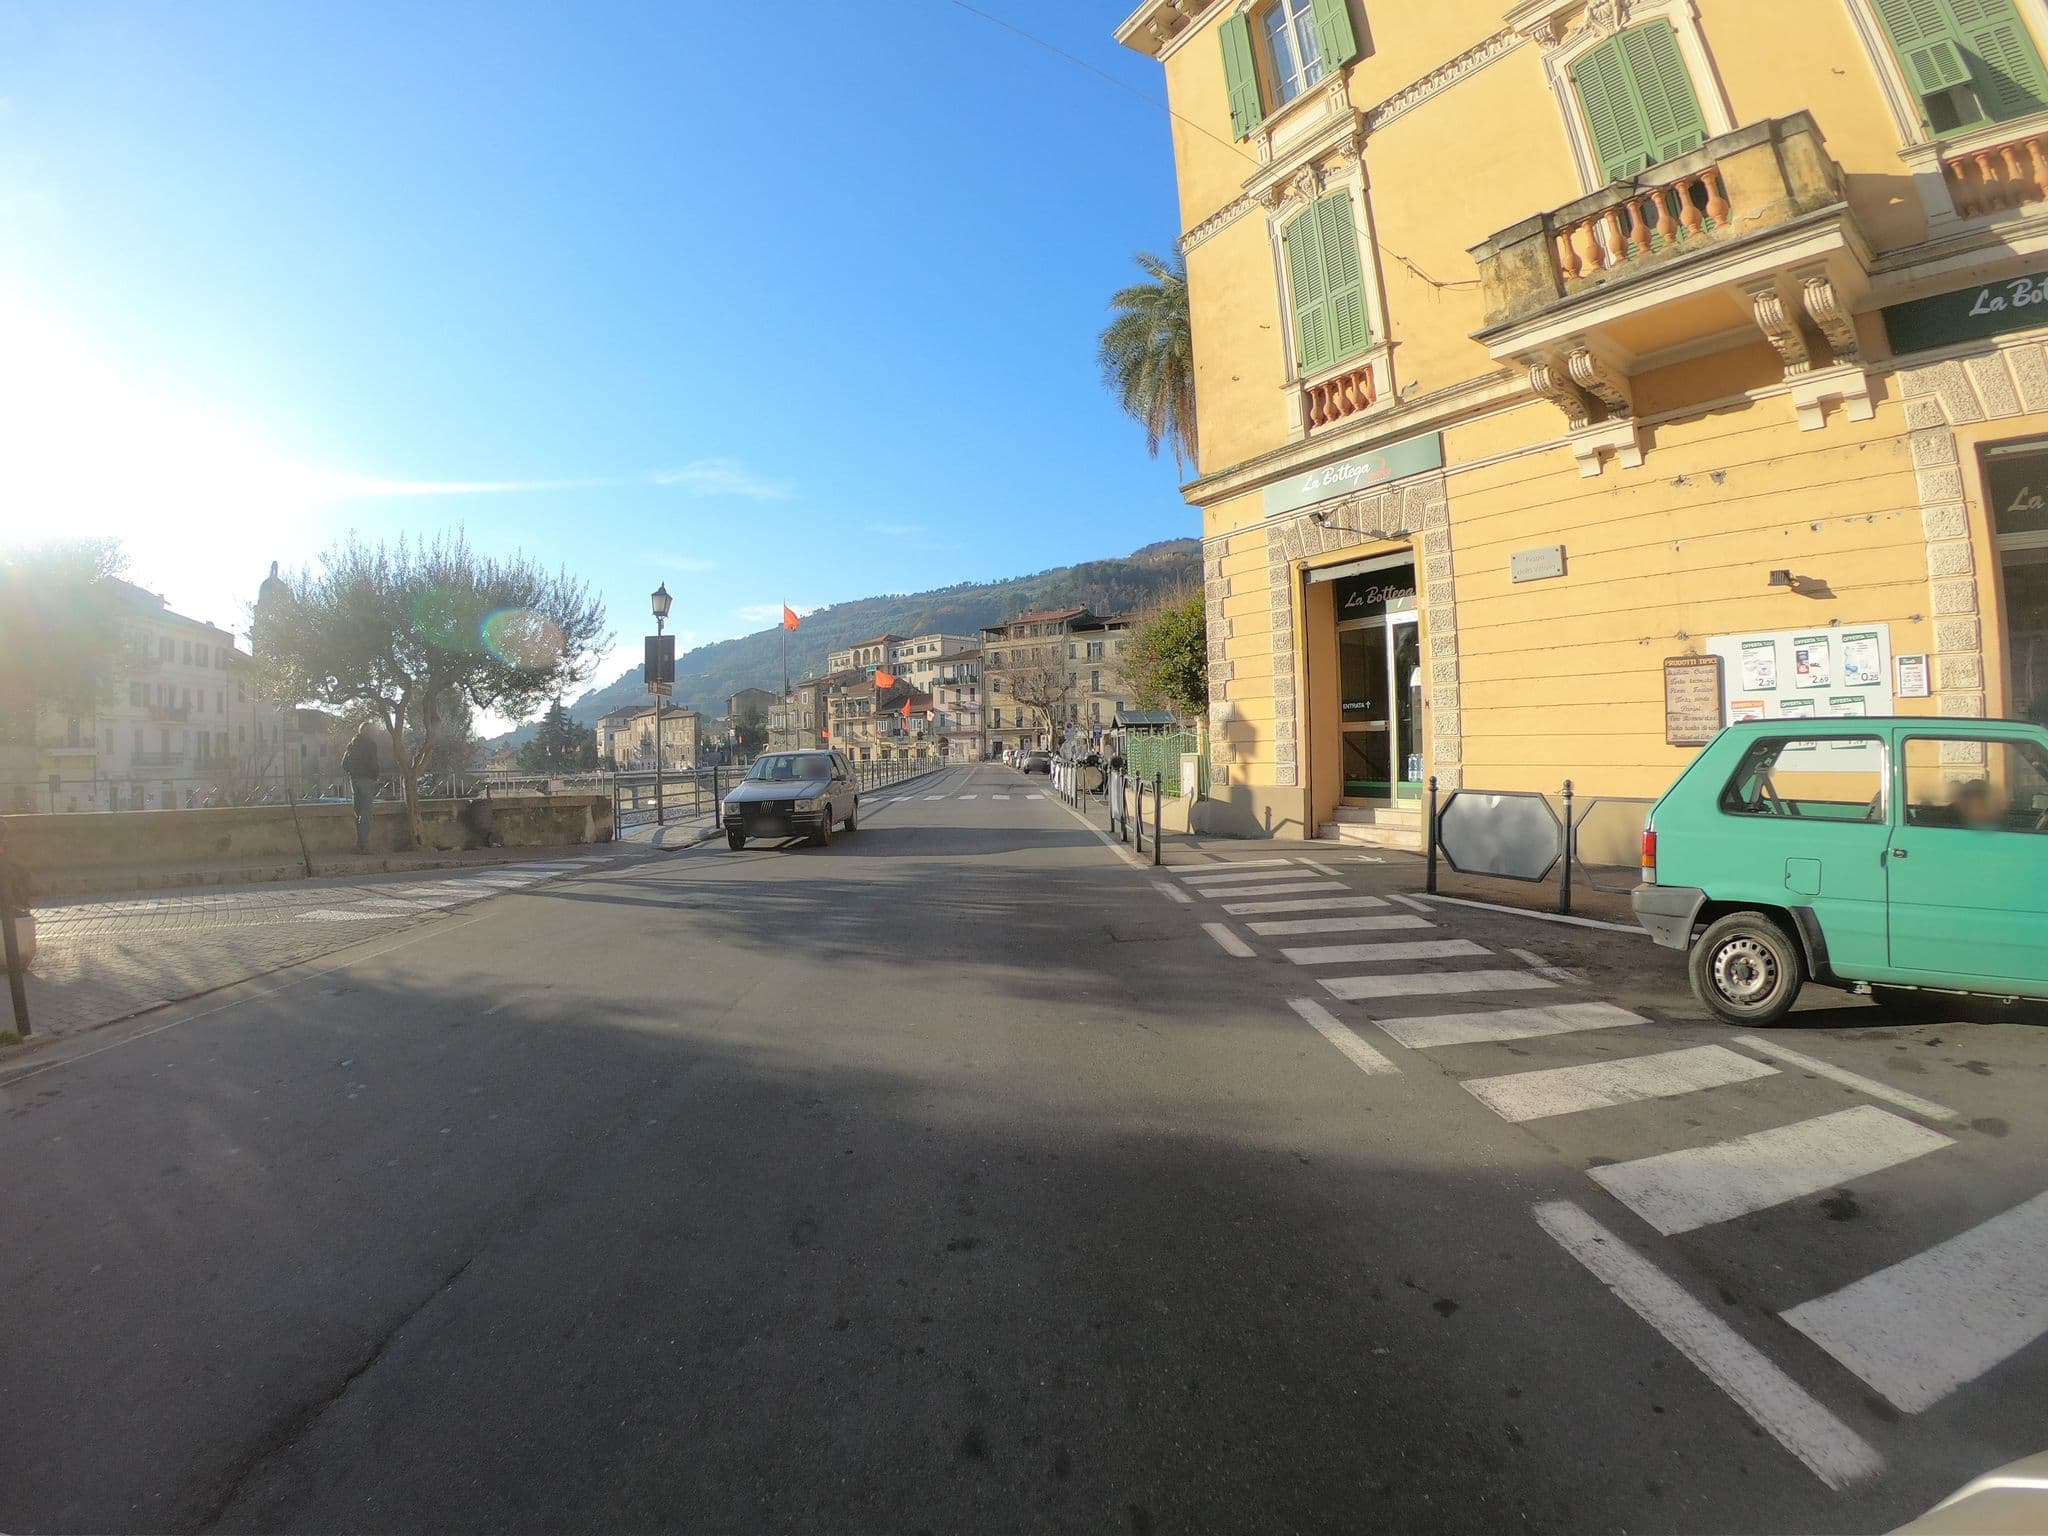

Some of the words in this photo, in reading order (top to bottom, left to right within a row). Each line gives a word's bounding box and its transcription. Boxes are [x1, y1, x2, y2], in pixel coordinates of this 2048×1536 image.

[1969, 289, 2008, 317] La
[1302, 474, 1320, 492] La
[1321, 463, 1371, 488] Bottega
[2007, 486, 2046, 512] La
[1344, 591, 1364, 608] La
[1365, 584, 1416, 608] Bottega
